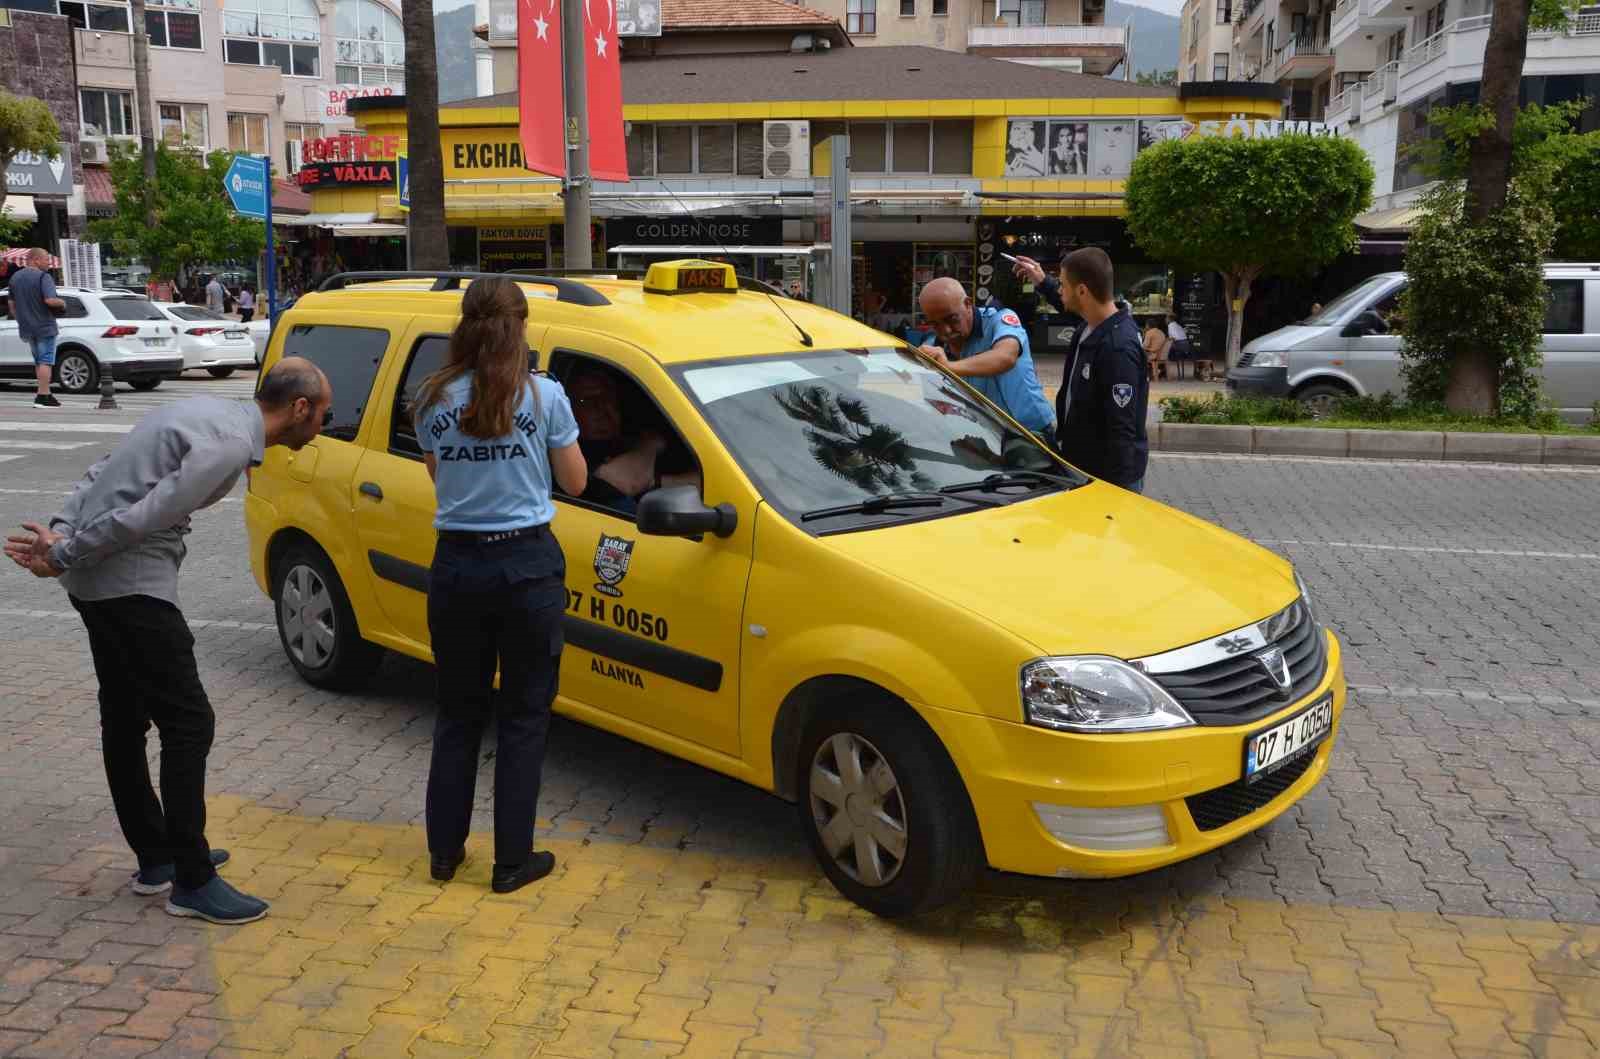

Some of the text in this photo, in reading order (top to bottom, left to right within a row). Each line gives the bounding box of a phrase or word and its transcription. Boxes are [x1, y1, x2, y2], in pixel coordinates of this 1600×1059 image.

[453, 143, 528, 169] EXCHA
[636, 224, 751, 238] GOLDEN ROSE
[439, 443, 528, 462] ZABITA
[590, 596, 605, 621] H
[612, 603, 669, 642] 0050
[591, 656, 645, 690] ALANYA
[1257, 731, 1279, 767] 07
[1283, 720, 1295, 755] H
[1300, 702, 1330, 745] 0050
